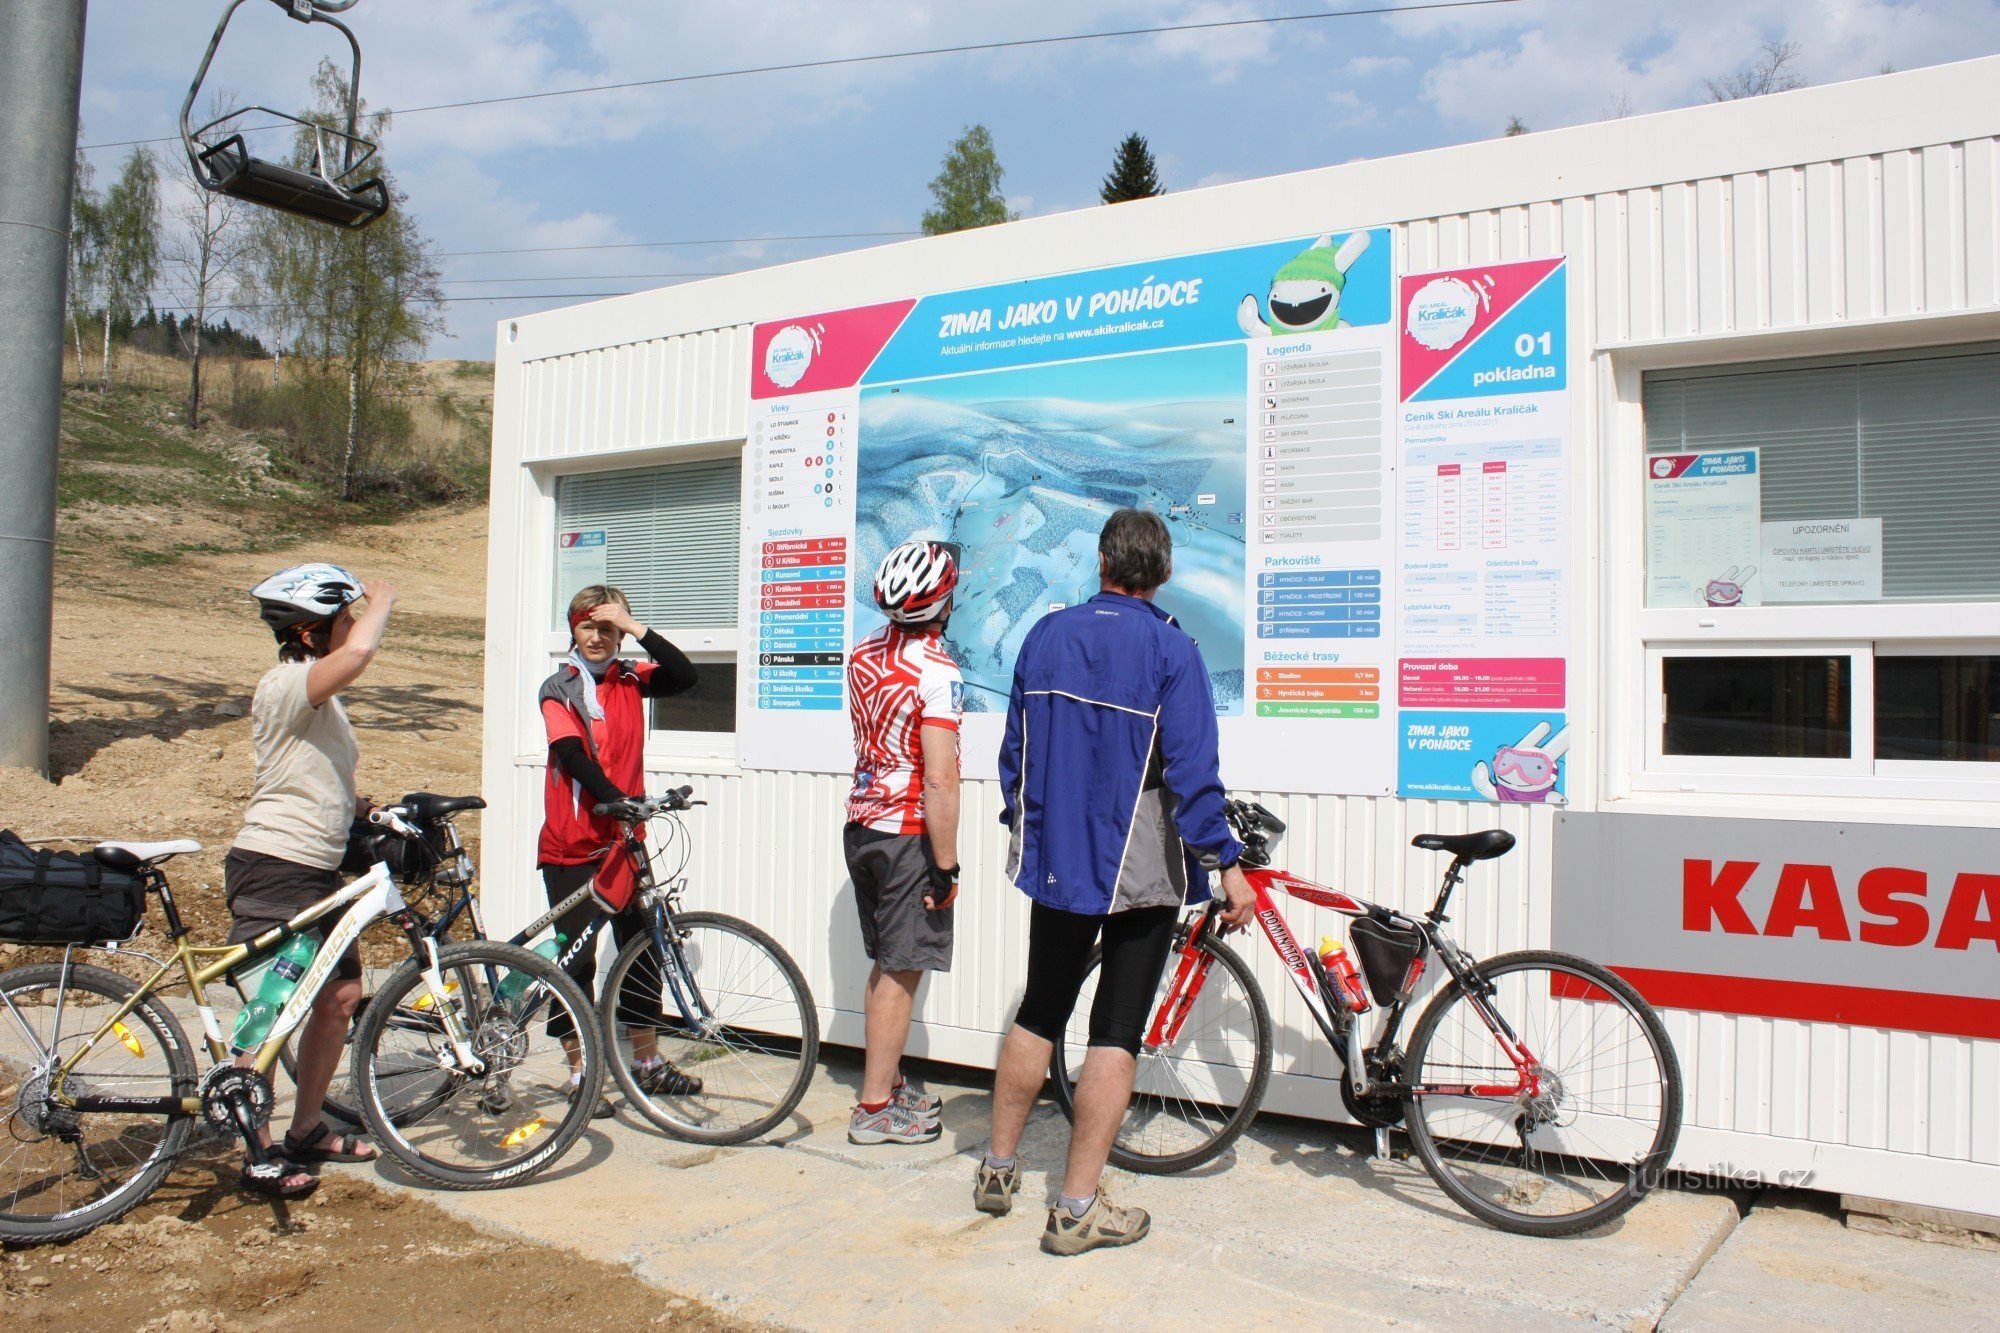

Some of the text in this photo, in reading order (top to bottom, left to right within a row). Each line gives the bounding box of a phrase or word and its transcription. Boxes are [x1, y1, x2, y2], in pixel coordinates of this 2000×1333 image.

[938, 275, 1202, 338] ZIMA JAKO V POHÁDCE
[1418, 306, 1466, 321] Kraličák
[940, 319, 1165, 356] Aktuální informace hledejte na www.skikralicak.cz
[1514, 331, 1551, 357] 01
[1266, 342, 1312, 356] Legenda
[1473, 364, 1556, 387] pokladna
[770, 404, 790, 413] Vleky
[1405, 403, 1538, 422] Ceník Ski Areálu Kraličák
[1701, 455, 1745, 465] ZIMA JAKO
[1702, 463, 1747, 474] V POHÁDCE
[767, 527, 803, 537] Sjezdovky
[1792, 523, 1850, 535] UPOZORNĚNÍ
[1264, 555, 1321, 567] Parkoviště
[1263, 651, 1340, 662] Běžecké trasy
[772, 699, 801, 707] Snowpark
[1407, 724, 1470, 736] ZIMA JAKO
[1407, 736, 1473, 751] V POHÁDCE
[1407, 783, 1472, 792] www.skikralicak.cz
[1683, 858, 2000, 953] KASA
[1261, 909, 1306, 972] DOMINATOR
[288, 912, 358, 1019] MERIDA
[492, 1141, 558, 1180] MERIDA
